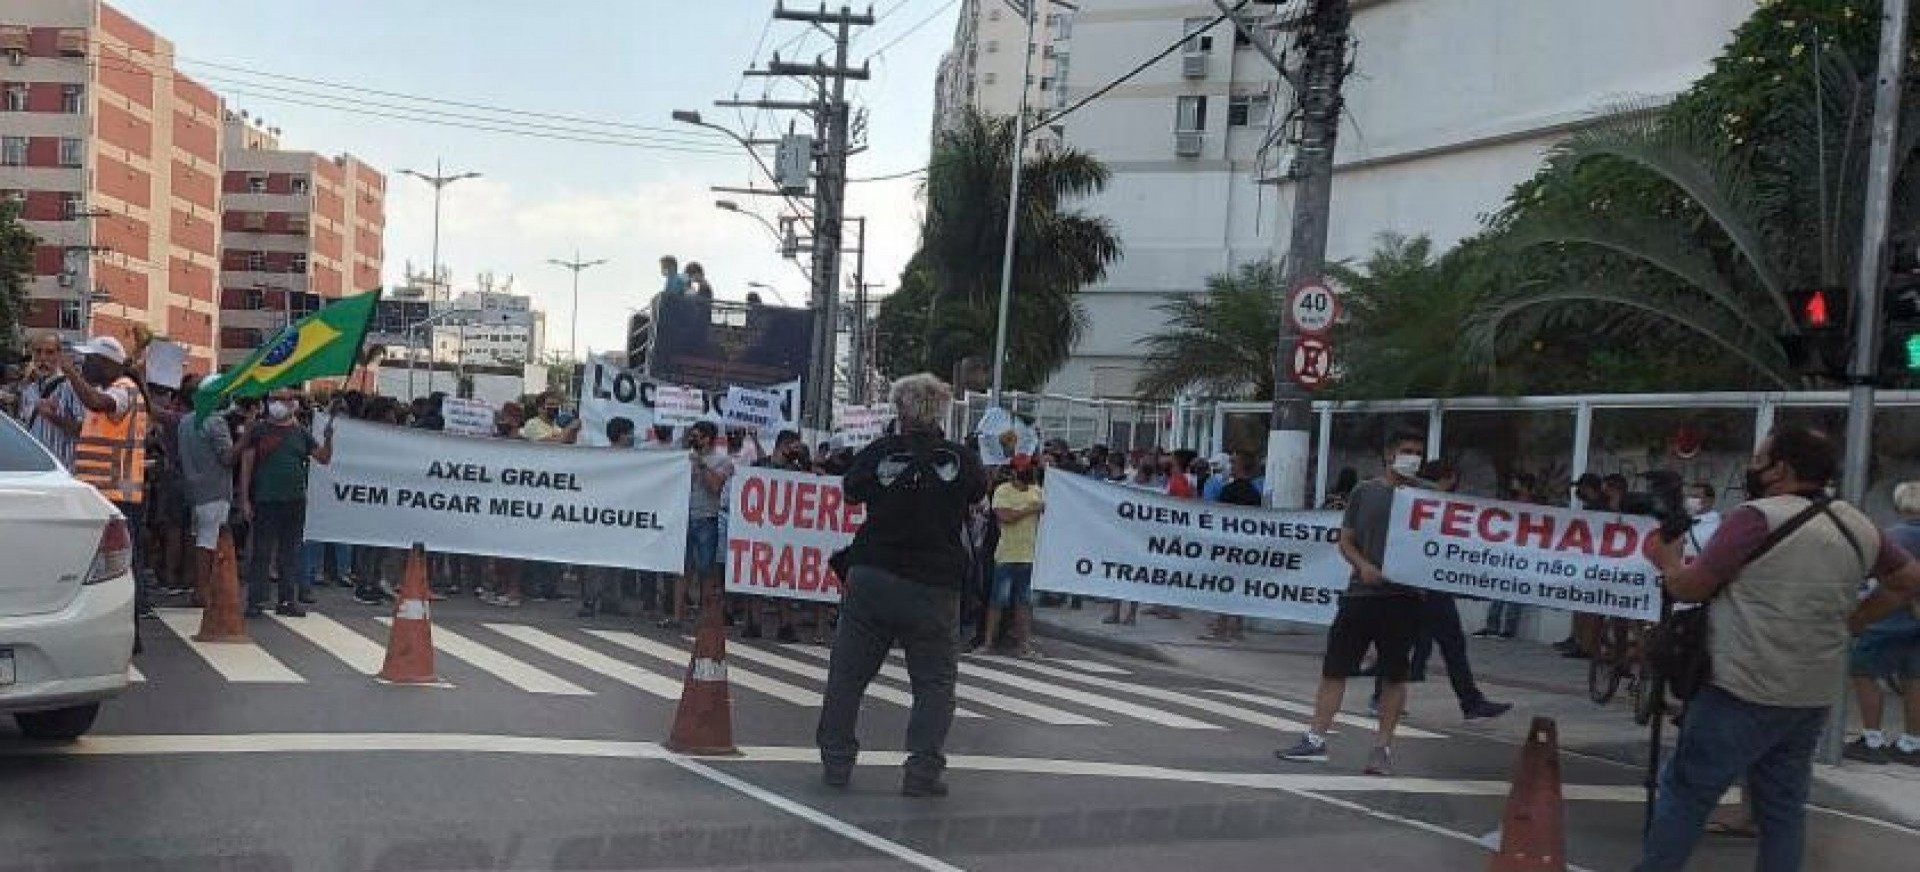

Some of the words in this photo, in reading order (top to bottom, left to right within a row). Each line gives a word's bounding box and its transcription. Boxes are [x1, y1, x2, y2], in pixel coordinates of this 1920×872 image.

[1300, 293, 1327, 311] 40
[427, 461, 492, 483] AXEL
[500, 468, 582, 492] GRAEL
[334, 483, 389, 505] VEM
[397, 489, 480, 514] PAGAR
[490, 498, 543, 520] MEU
[551, 504, 664, 530] ALUGUEL
[1117, 502, 1190, 527] QUEM
[1199, 508, 1213, 530] É
[1148, 535, 1203, 559] NÃO
[1210, 545, 1302, 570] PROÍBE
[1424, 541, 1440, 557] O
[1446, 544, 1529, 571] Prefeito
[1536, 559, 1577, 578] não
[1584, 563, 1646, 587] deixa
[1075, 558, 1093, 575] O
[1102, 562, 1235, 593] TRABALHO
[1433, 566, 1531, 596] comércio
[1538, 581, 1650, 611] trabalhar!
